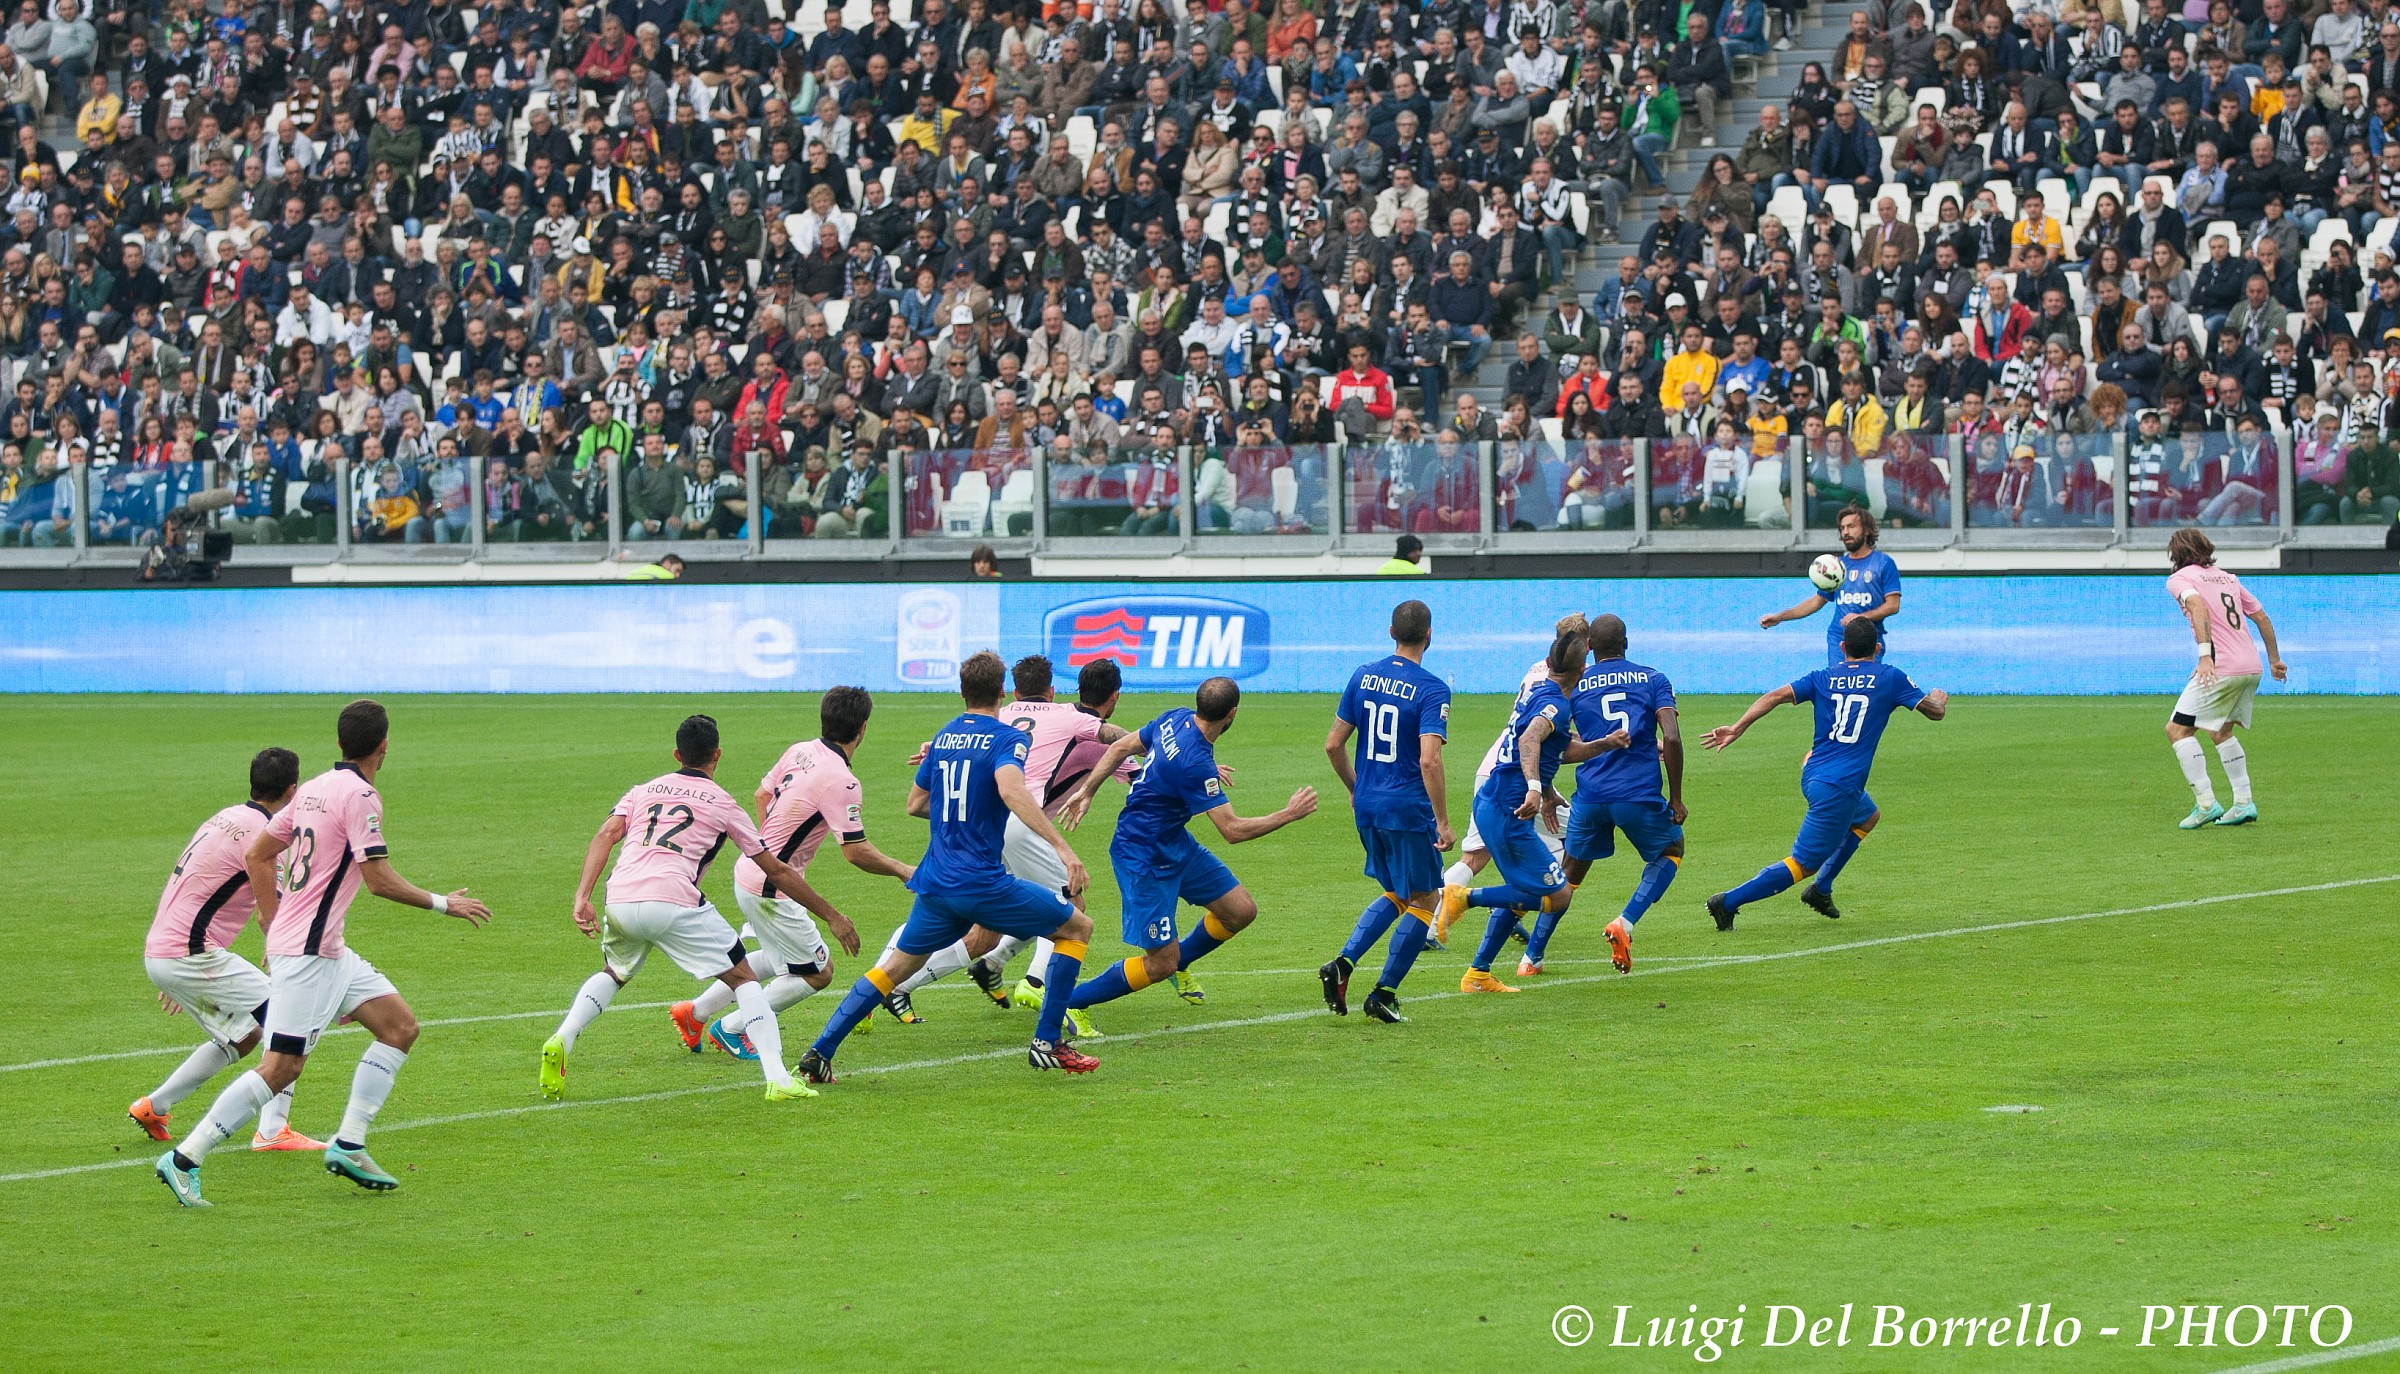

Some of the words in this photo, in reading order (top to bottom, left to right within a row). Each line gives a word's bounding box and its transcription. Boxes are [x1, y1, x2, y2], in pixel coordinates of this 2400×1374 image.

[1837, 590, 1873, 607] Jeep
[2220, 592, 2241, 631] 8
[941, 638, 951, 652] A
[1147, 615, 1246, 668] TIM
[926, 662, 952, 678] TIM
[1578, 670, 1649, 693] OGBONNA
[1829, 674, 1876, 690] TEVEZ
[1360, 674, 1418, 702] BONUCCI
[1600, 692, 1630, 736] 5
[1828, 693, 1870, 744] 10
[1363, 700, 1400, 764] 19
[647, 783, 717, 806] GONZALEZ
[938, 759, 972, 823] 14
[642, 802, 696, 855] 12
[174, 832, 209, 885] 4
[1159, 916, 1172, 941] 3
